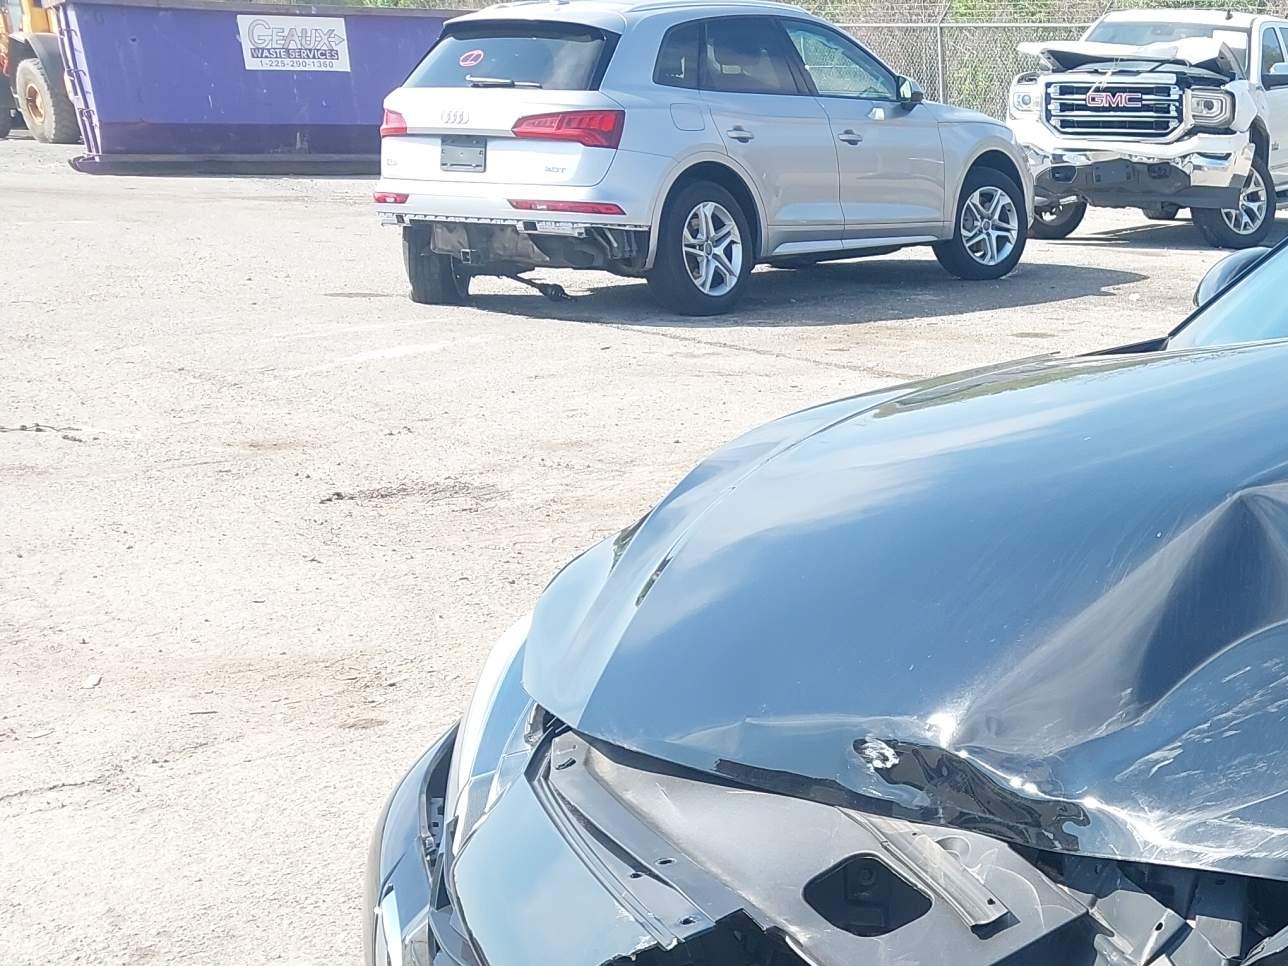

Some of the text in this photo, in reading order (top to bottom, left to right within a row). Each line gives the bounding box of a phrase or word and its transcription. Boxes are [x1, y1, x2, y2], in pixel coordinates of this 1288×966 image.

[248, 18, 335, 49] GEAUX
[251, 48, 338, 59] WASTE SERVICES
[1086, 93, 1142, 107] GMC
